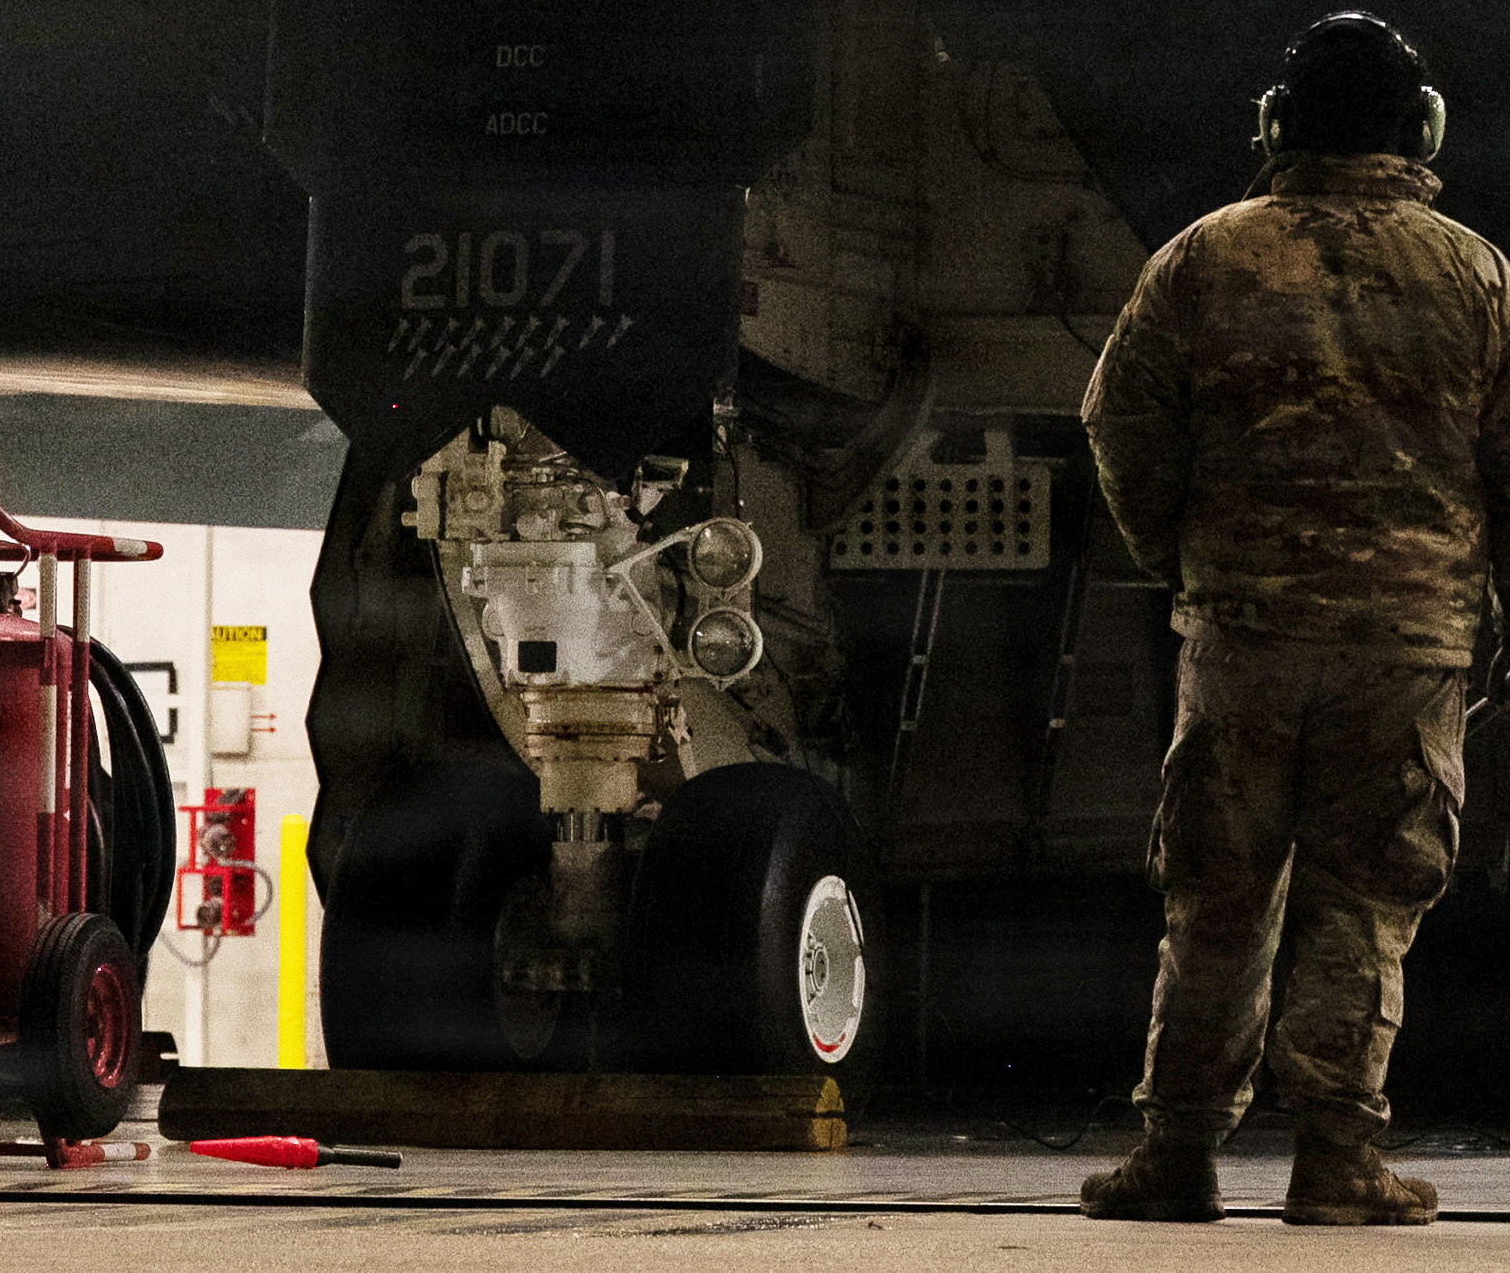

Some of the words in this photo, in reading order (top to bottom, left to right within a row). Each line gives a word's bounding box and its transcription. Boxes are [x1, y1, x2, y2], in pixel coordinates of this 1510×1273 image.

[496, 45, 545, 68] DCC
[486, 112, 549, 135] ADCC
[401, 228, 616, 310] 21071
[211, 627, 263, 641] AUTION
